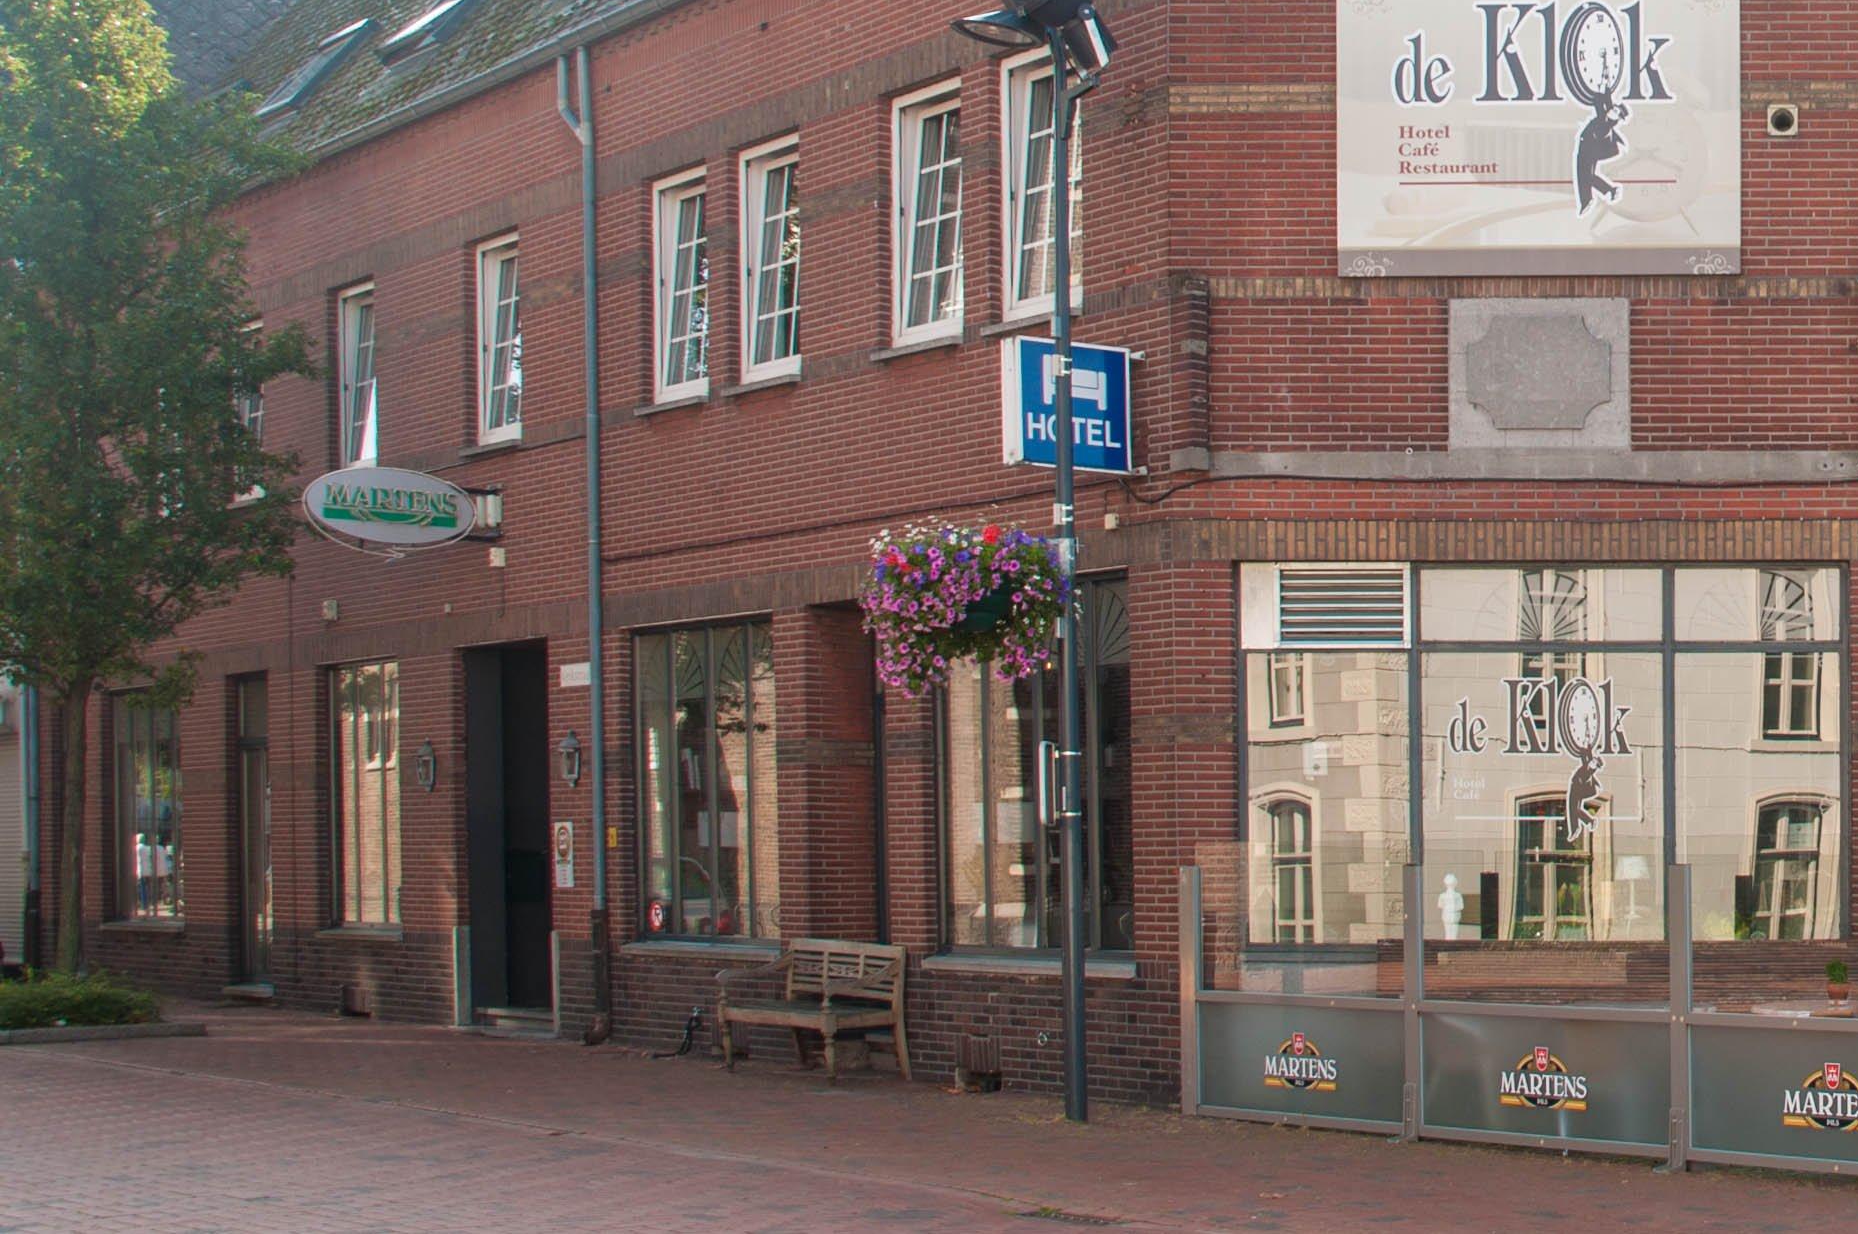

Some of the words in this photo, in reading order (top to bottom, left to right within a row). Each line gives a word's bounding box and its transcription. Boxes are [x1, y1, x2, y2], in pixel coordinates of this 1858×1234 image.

[1394, 33, 1451, 104] de
[1398, 125, 1451, 139] Hotel
[1398, 142, 1440, 157] Café
[1398, 160, 1498, 174] Restaurant
[324, 483, 458, 515] MARTENS
[1450, 699, 1487, 752] de
[1453, 777, 1486, 789] Hotel
[1264, 1055, 1337, 1080] MARTENS
[1500, 1071, 1587, 1098] MARTENS
